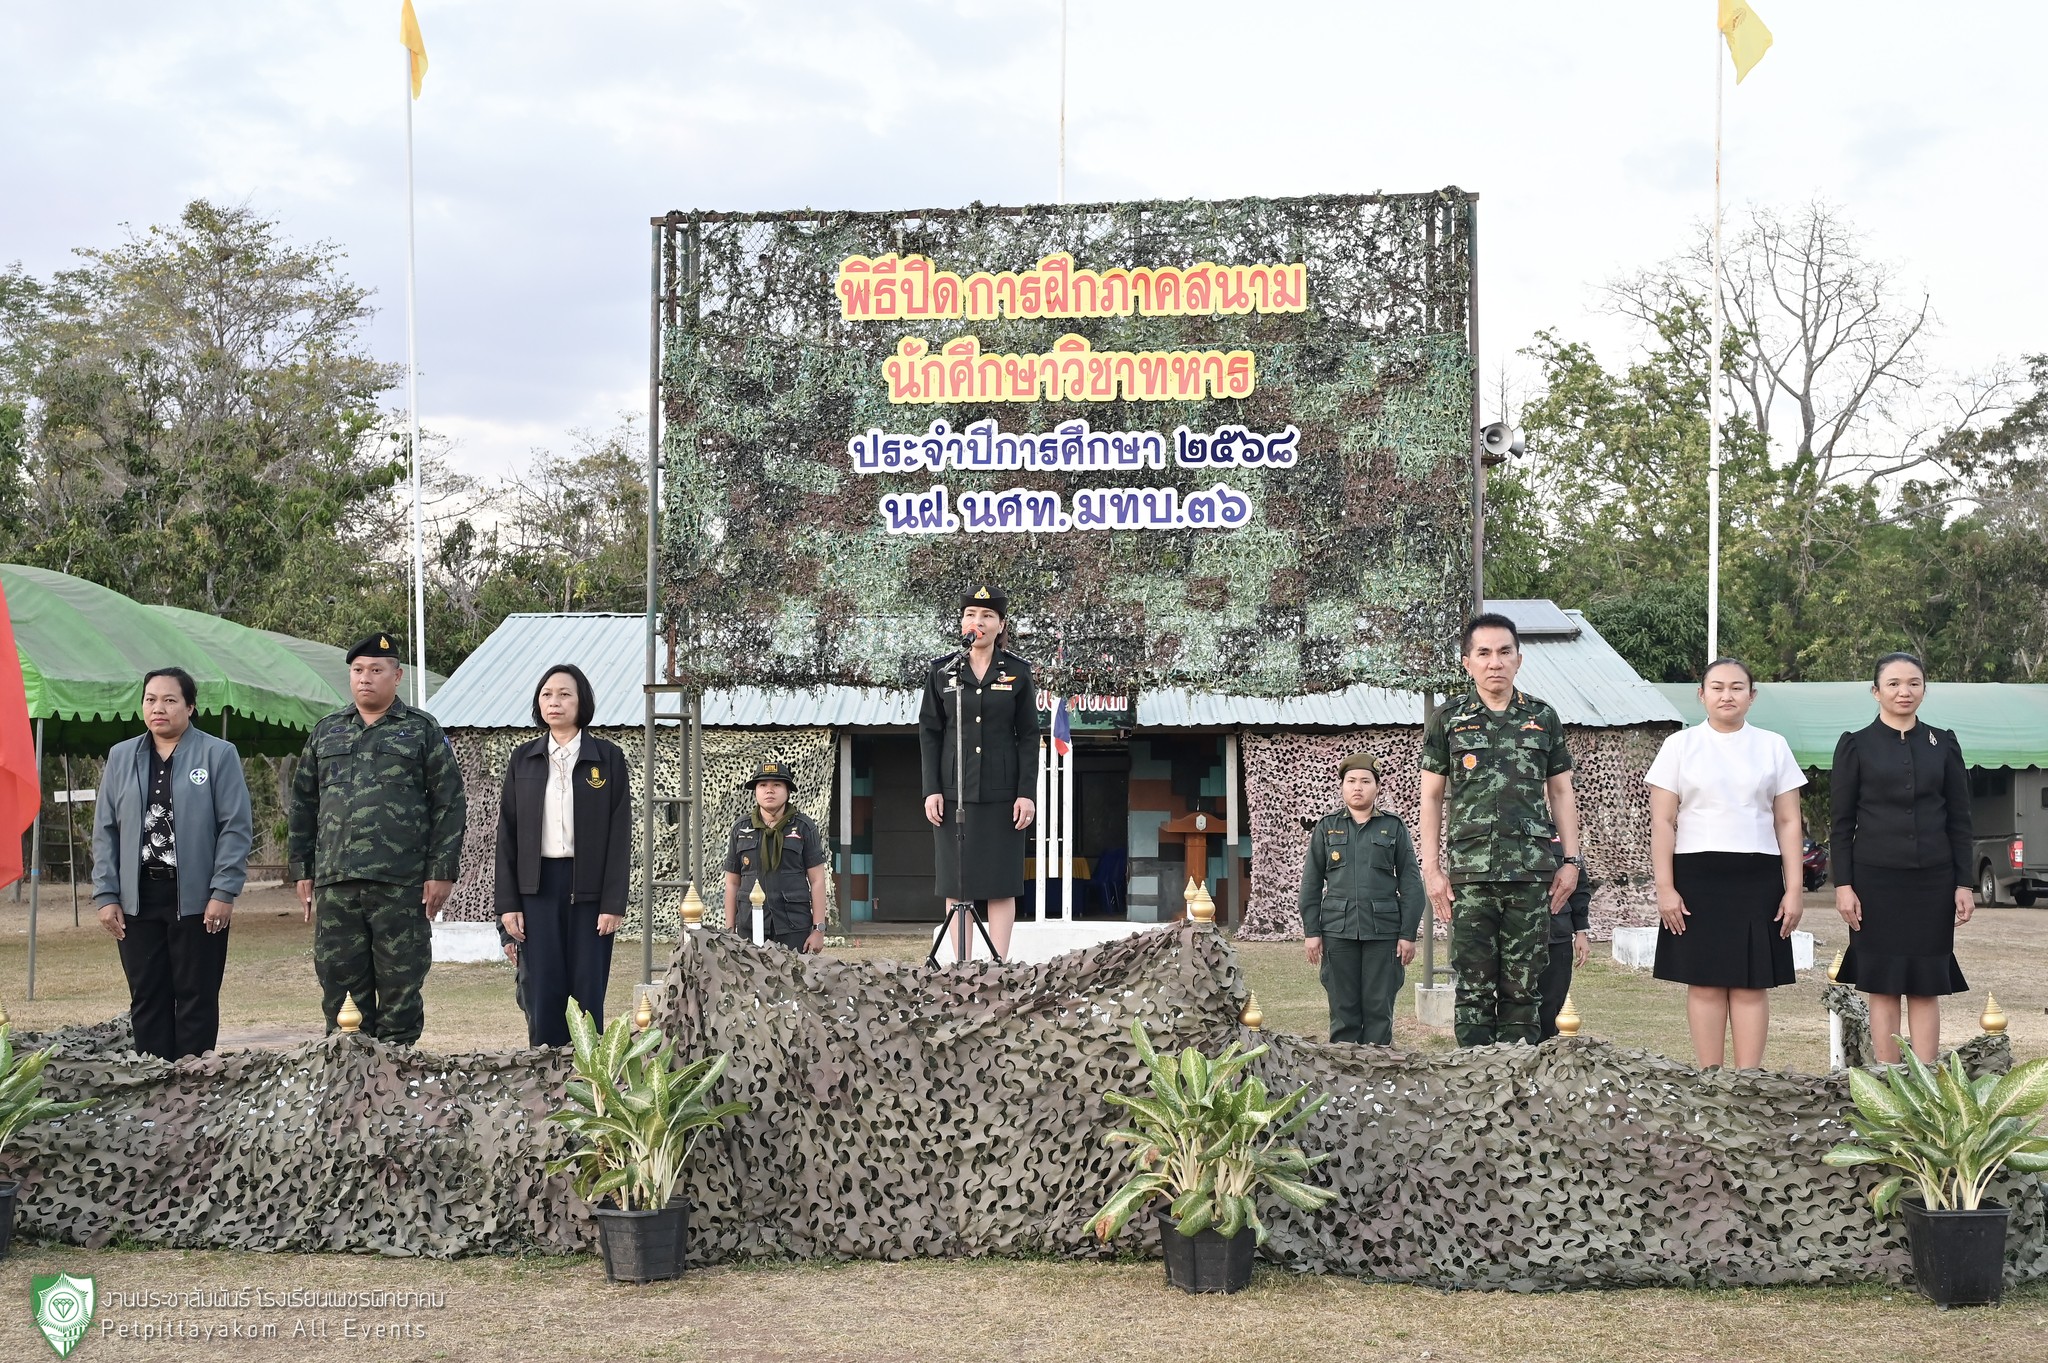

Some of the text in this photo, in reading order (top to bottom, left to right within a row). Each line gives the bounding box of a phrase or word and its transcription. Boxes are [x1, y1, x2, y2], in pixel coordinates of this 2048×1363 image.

[888, 339, 1249, 398] นักศึกษาวิชาทหาร
[853, 424, 1296, 468] ประจำปีการศึกษา ๒๕๖๘
